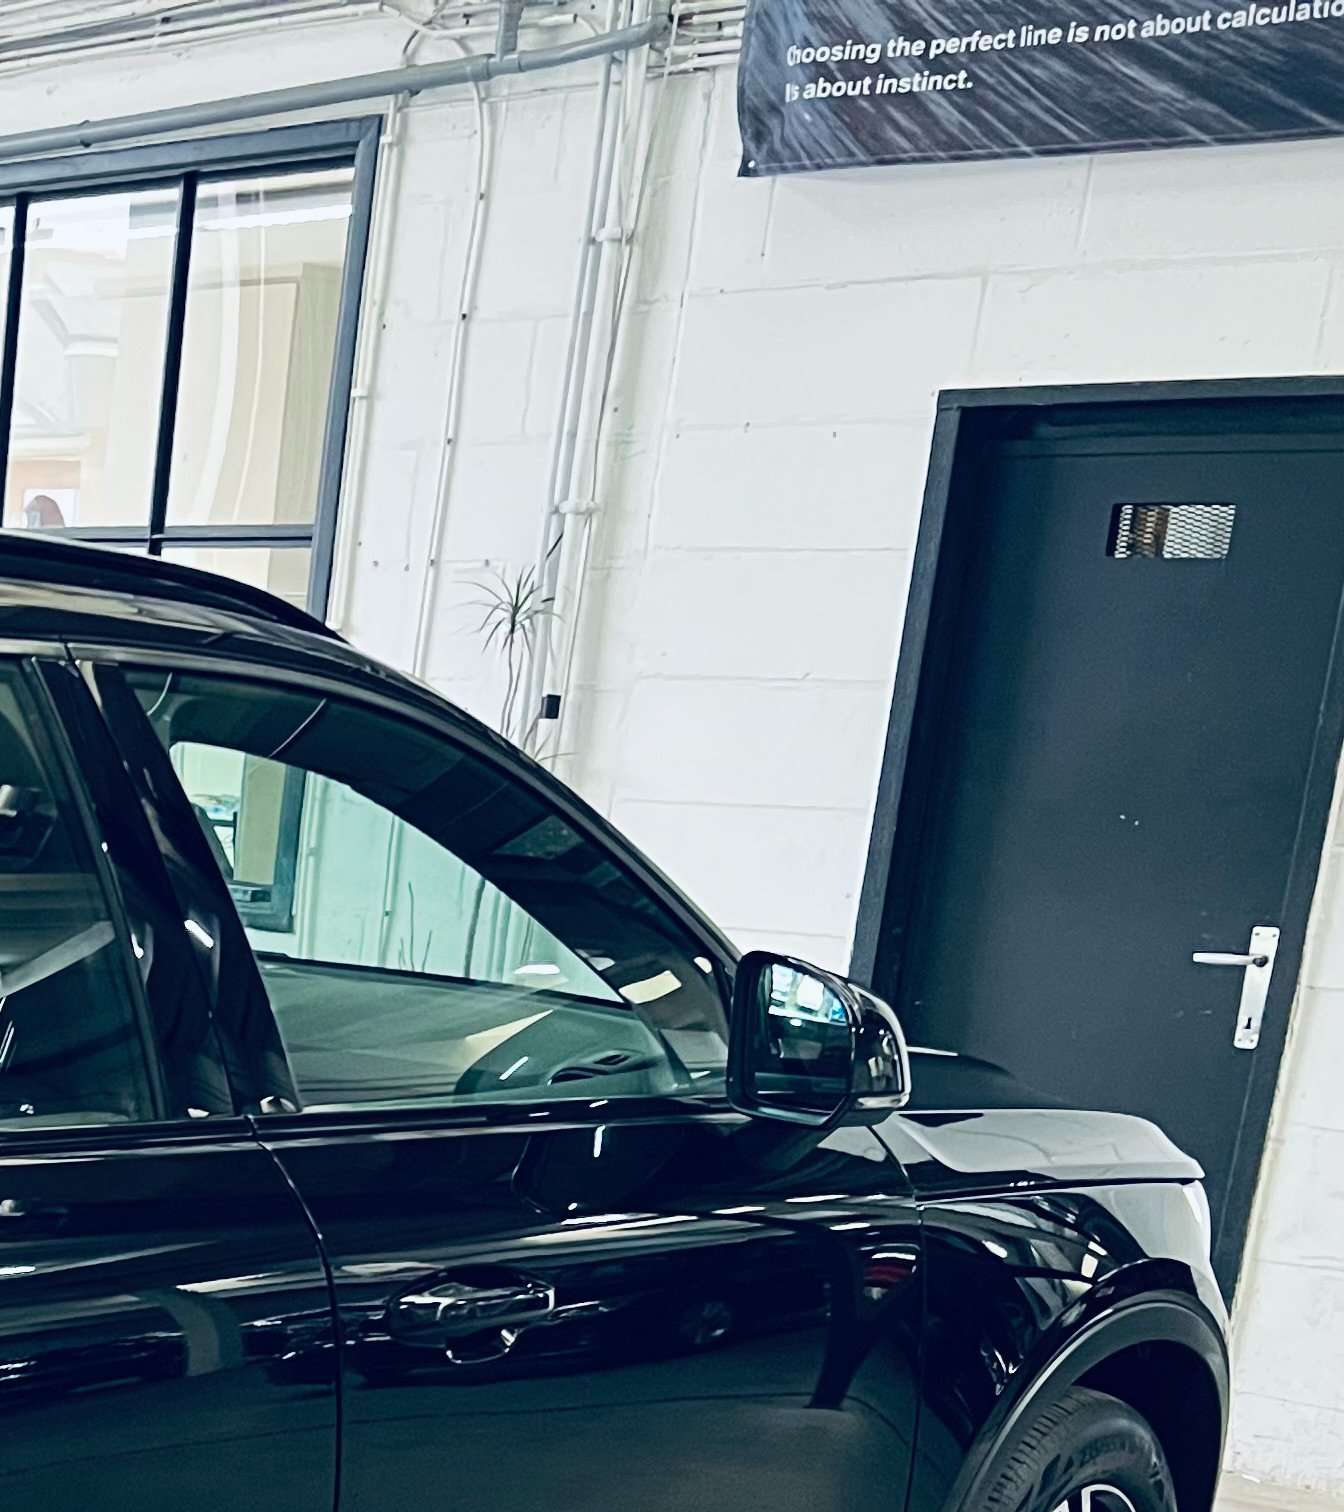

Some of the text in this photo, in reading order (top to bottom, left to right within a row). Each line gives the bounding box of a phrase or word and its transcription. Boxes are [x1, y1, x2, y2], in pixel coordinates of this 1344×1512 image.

[786, 39, 883, 66] Choosing
[887, 35, 925, 58] the
[928, 28, 1016, 60] perfect
[1020, 24, 1062, 48] line
[1067, 21, 1090, 44] is
[1094, 18, 1137, 42] not
[1140, 13, 1212, 39] about
[802, 76, 871, 100] about
[875, 69, 974, 95] instinct.
